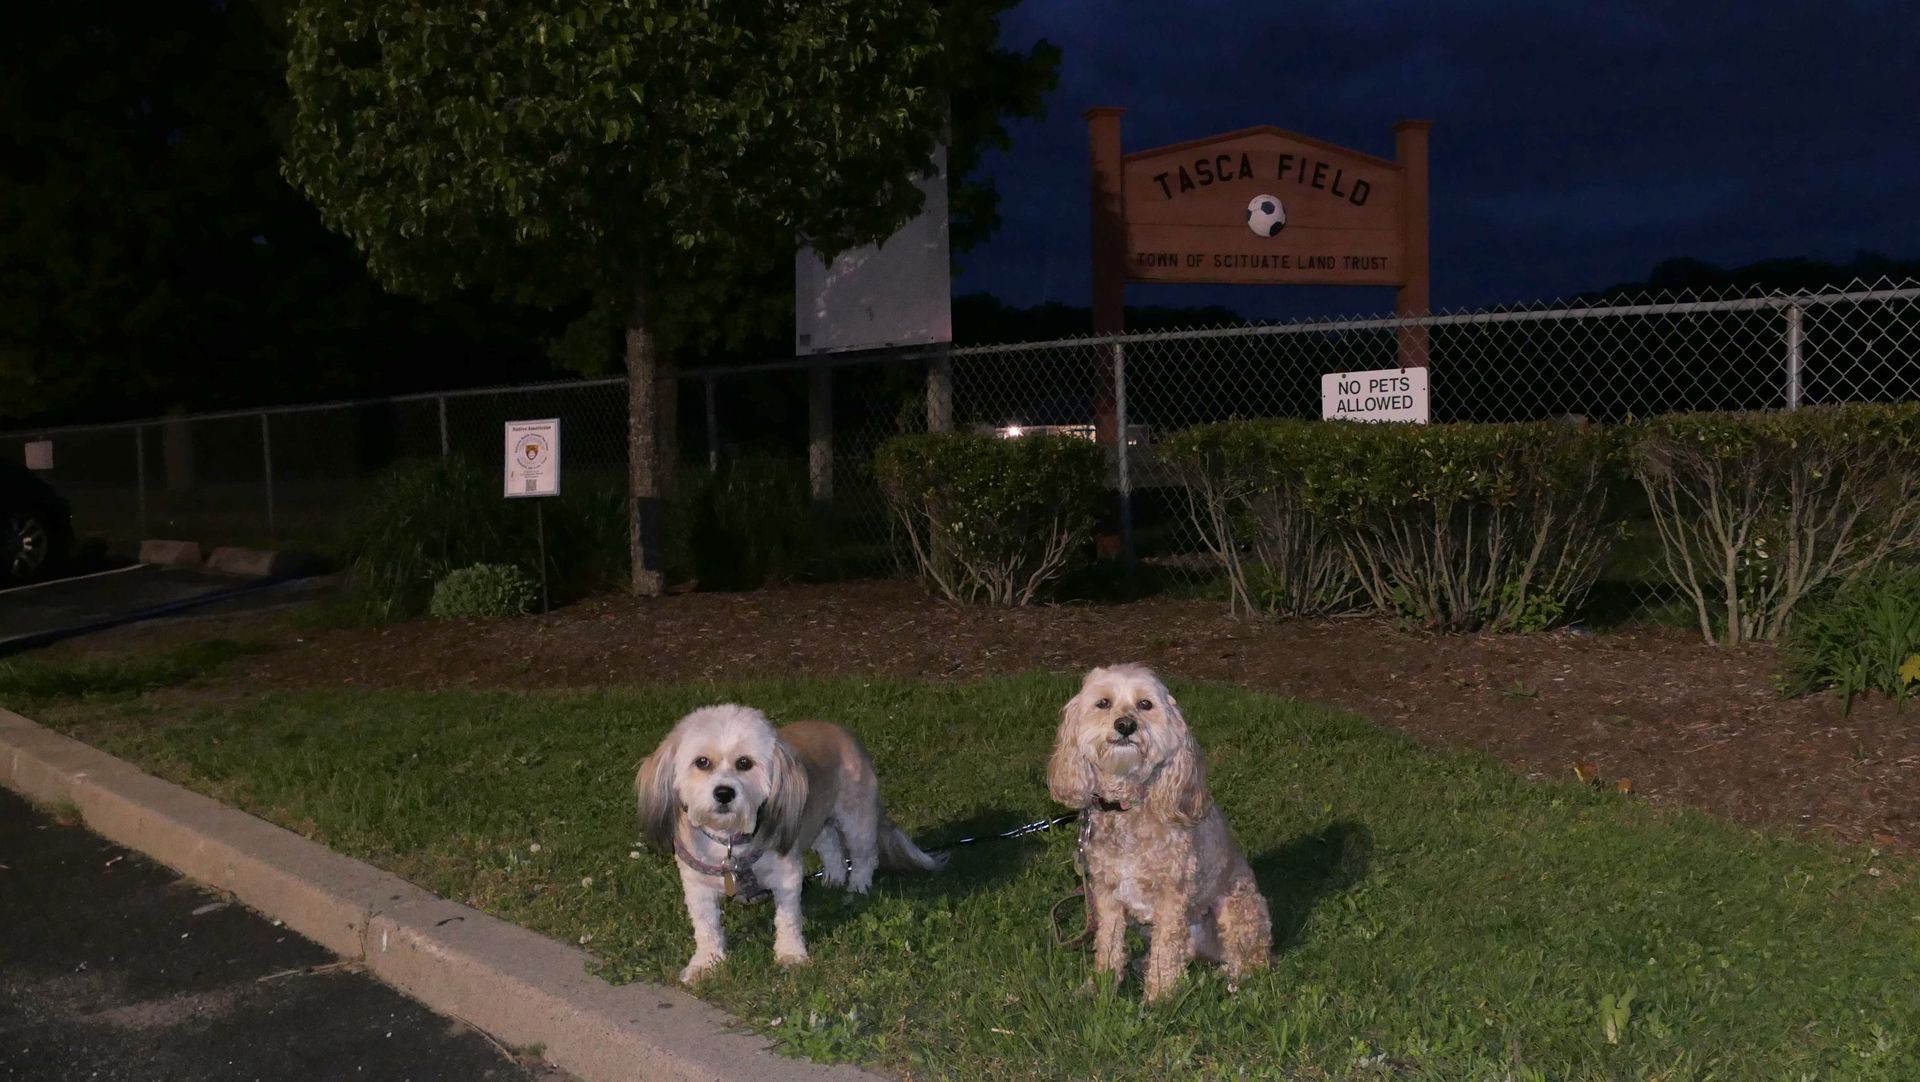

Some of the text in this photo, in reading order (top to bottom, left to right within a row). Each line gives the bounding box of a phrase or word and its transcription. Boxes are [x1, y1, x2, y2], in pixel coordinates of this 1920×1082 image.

[1153, 153, 1371, 206] TASCA FIELD
[1138, 252, 1389, 271] TOWN OF SCITUATE LAND TRUST
[1338, 377, 1410, 395] NO PETS
[1336, 395, 1413, 413] ALLOWED
